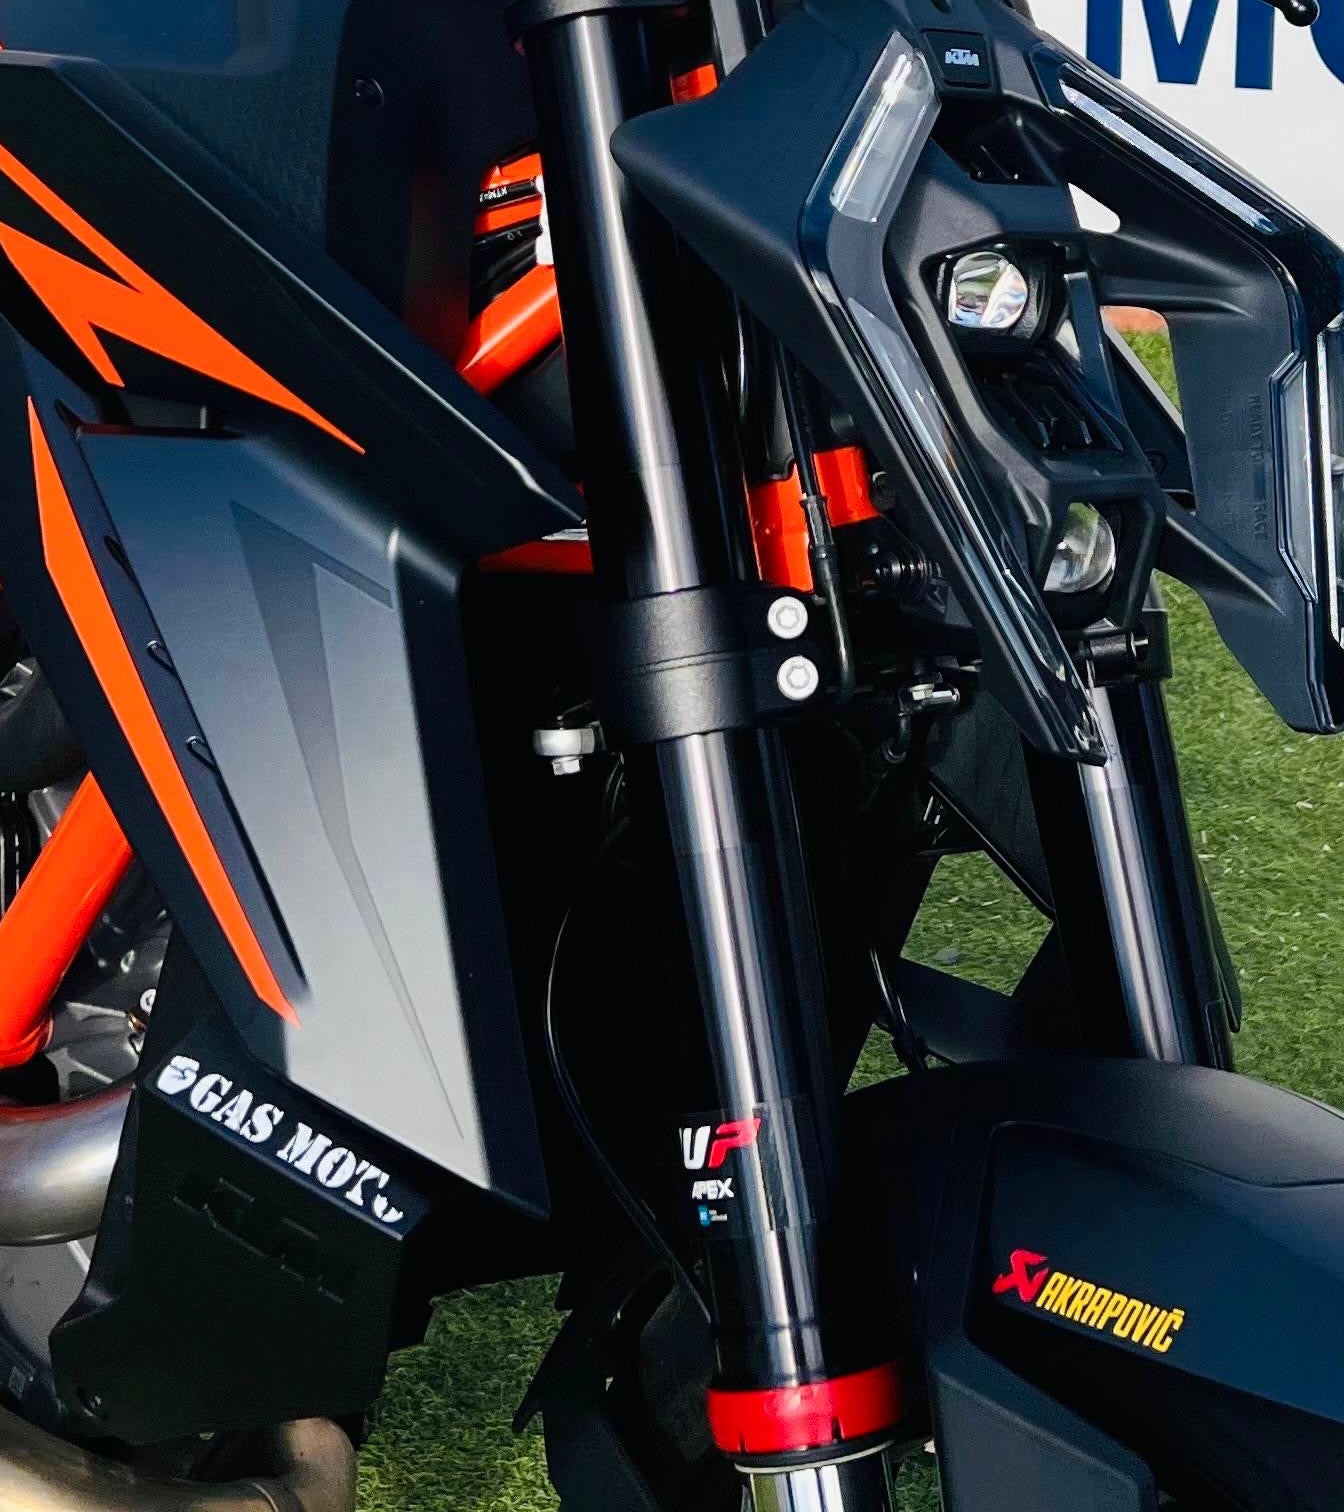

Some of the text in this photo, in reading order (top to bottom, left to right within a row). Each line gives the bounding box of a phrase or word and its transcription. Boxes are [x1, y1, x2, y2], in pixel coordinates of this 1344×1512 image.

[944, 48, 980, 66] KTM
[189, 1073, 285, 1144] GAS
[691, 1177, 735, 1200] APEX
